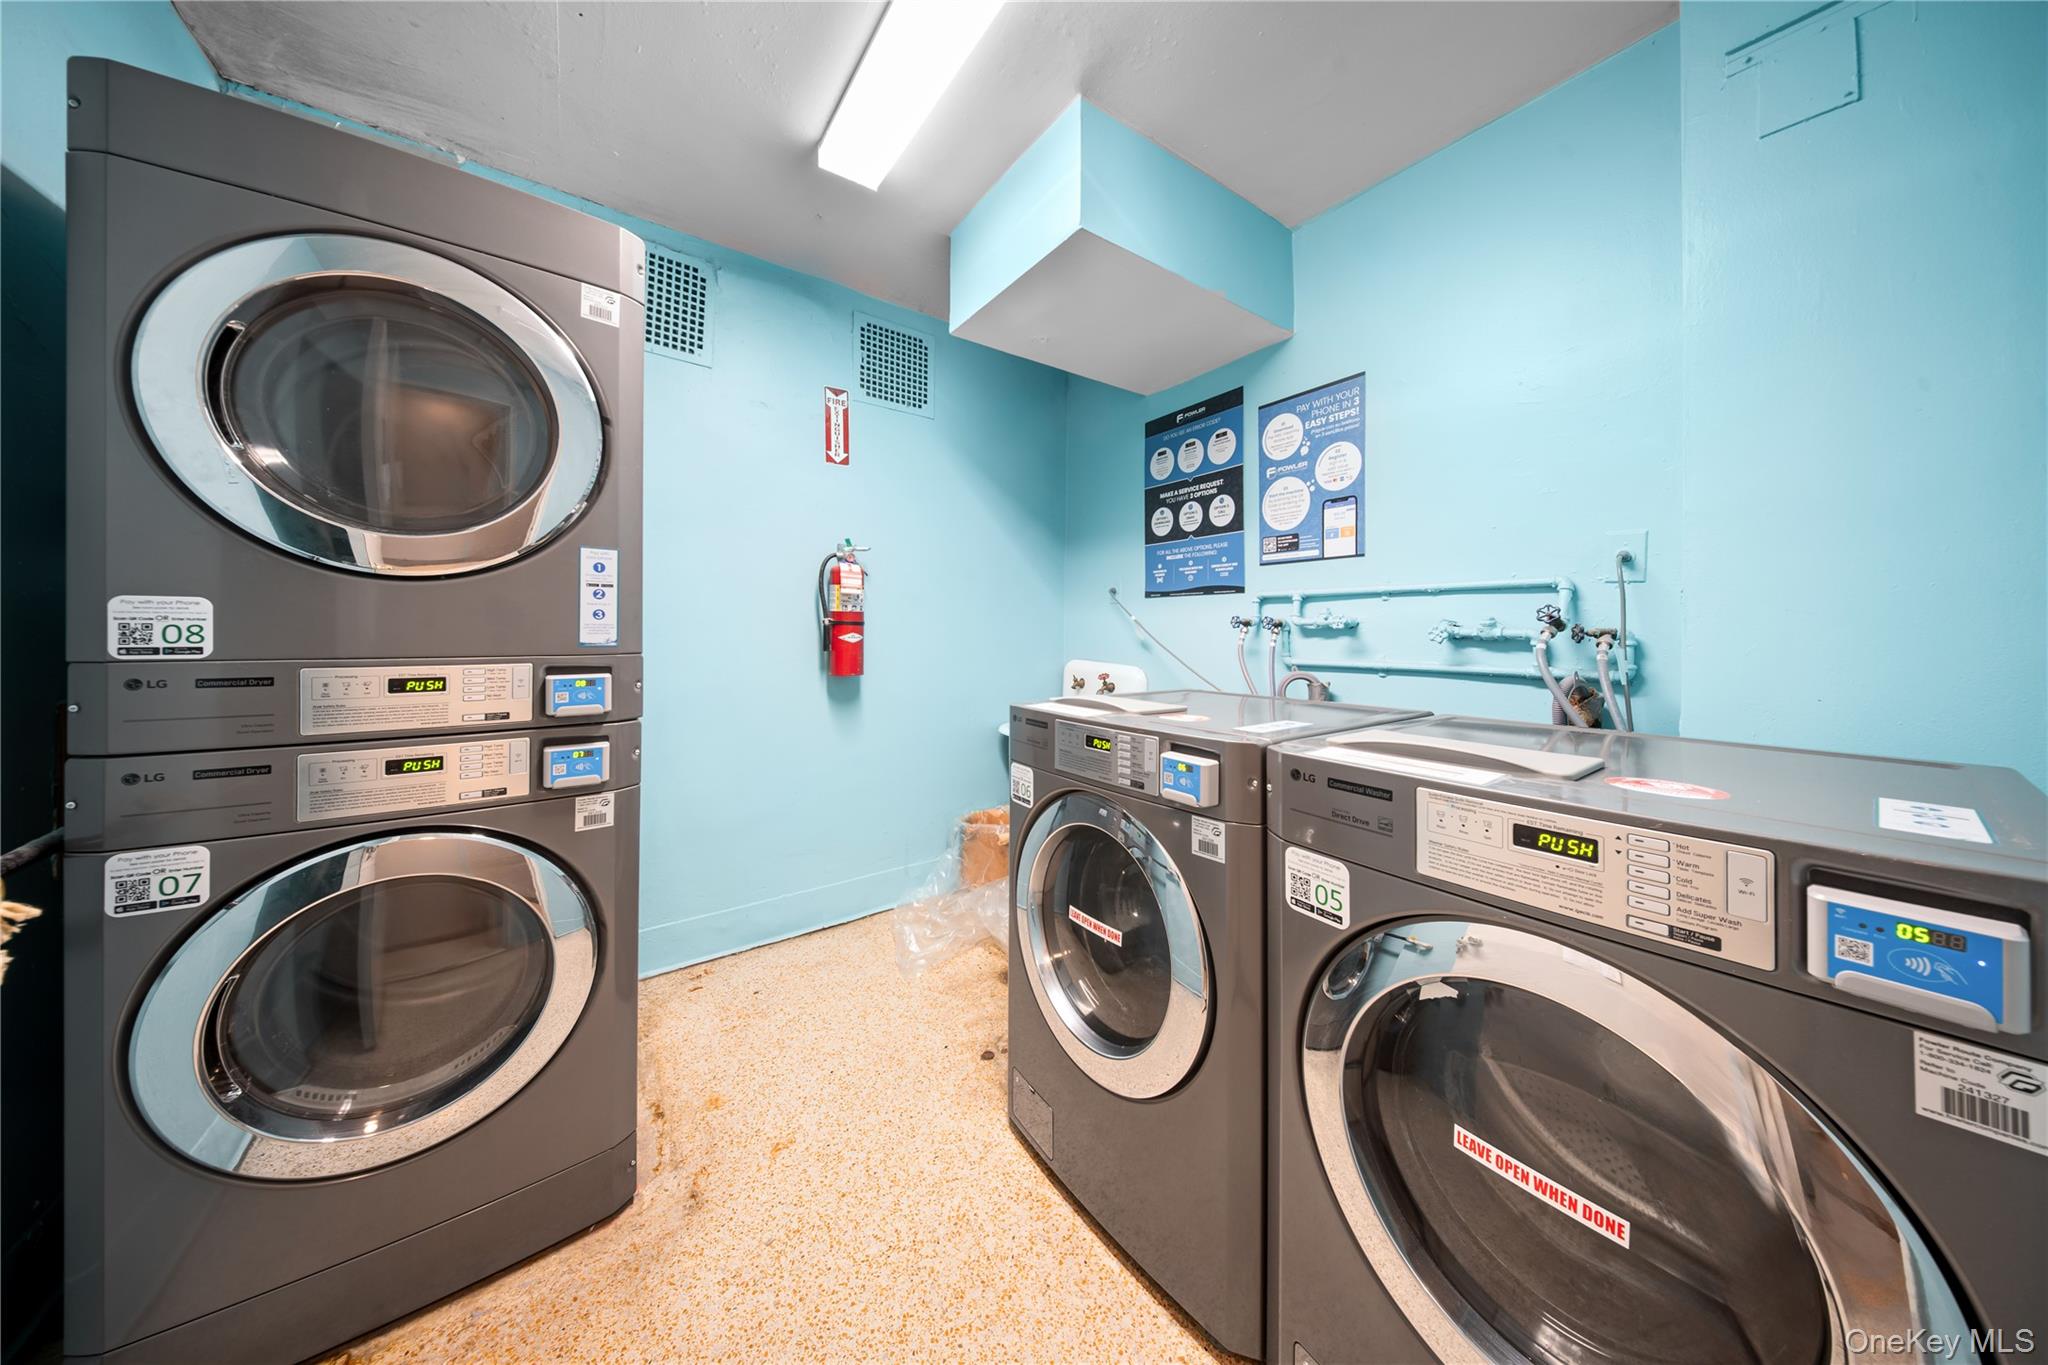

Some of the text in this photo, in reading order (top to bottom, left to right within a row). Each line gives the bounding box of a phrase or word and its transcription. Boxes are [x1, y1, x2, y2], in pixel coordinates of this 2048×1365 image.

[827, 398, 846, 407] FIRE
[1297, 387, 1360, 413] PAY WITH YOUR
[1312, 397, 1360, 418] PHONE IN 3
[1184, 407, 1206, 418] FOWLER
[1305, 417, 1328, 429] EASY
[1329, 407, 1360, 423] STEPS!
[1277, 461, 1308, 473] FOWLER
[1177, 494, 1190, 502] HAVE
[1194, 488, 1218, 499] OPTIONS
[1179, 484, 1199, 495] SERVICE
[162, 624, 205, 644] 08
[146, 680, 168, 689] LG
[249, 678, 273, 687] Dryer
[406, 681, 444, 691] PUSH
[1093, 739, 1111, 750] PUSH
[403, 760, 441, 772] PUSH
[144, 766, 270, 783] LG Commercial Dryer
[1021, 783, 1032, 799] 06
[1303, 772, 1391, 799] LG Commercial Washer
[1331, 811, 1351, 822] Direct
[1352, 816, 1370, 827] Drive
[1538, 834, 1594, 858] PUSH
[1676, 843, 1690, 851] Hot
[1324, 861, 1341, 870] Phone
[1676, 859, 1700, 871] Warm
[159, 873, 202, 896] 07
[1676, 875, 1693, 886] Cold
[1315, 884, 1343, 912] 05
[1676, 891, 1712, 905] Delicates
[1738, 889, 1756, 897] Wi-Fi
[1676, 907, 1743, 928] Add Super Wash
[1108, 929, 1121, 943] DONE
[1672, 927, 1690, 936] Start
[1695, 933, 1716, 943] Pause
[1896, 922, 1930, 944] 05
[1919, 1044, 1934, 1052] For
[1937, 1048, 1970, 1062] Service
[1919, 1037, 2033, 1073] Fowler Route Company
[1920, 1059, 1944, 1070] Refer
[1920, 1066, 1987, 1090] Machine Code
[1958, 1084, 2010, 1104] 241327
[1457, 1130, 1626, 1241] LEAVE OPEN WHEN DONE
